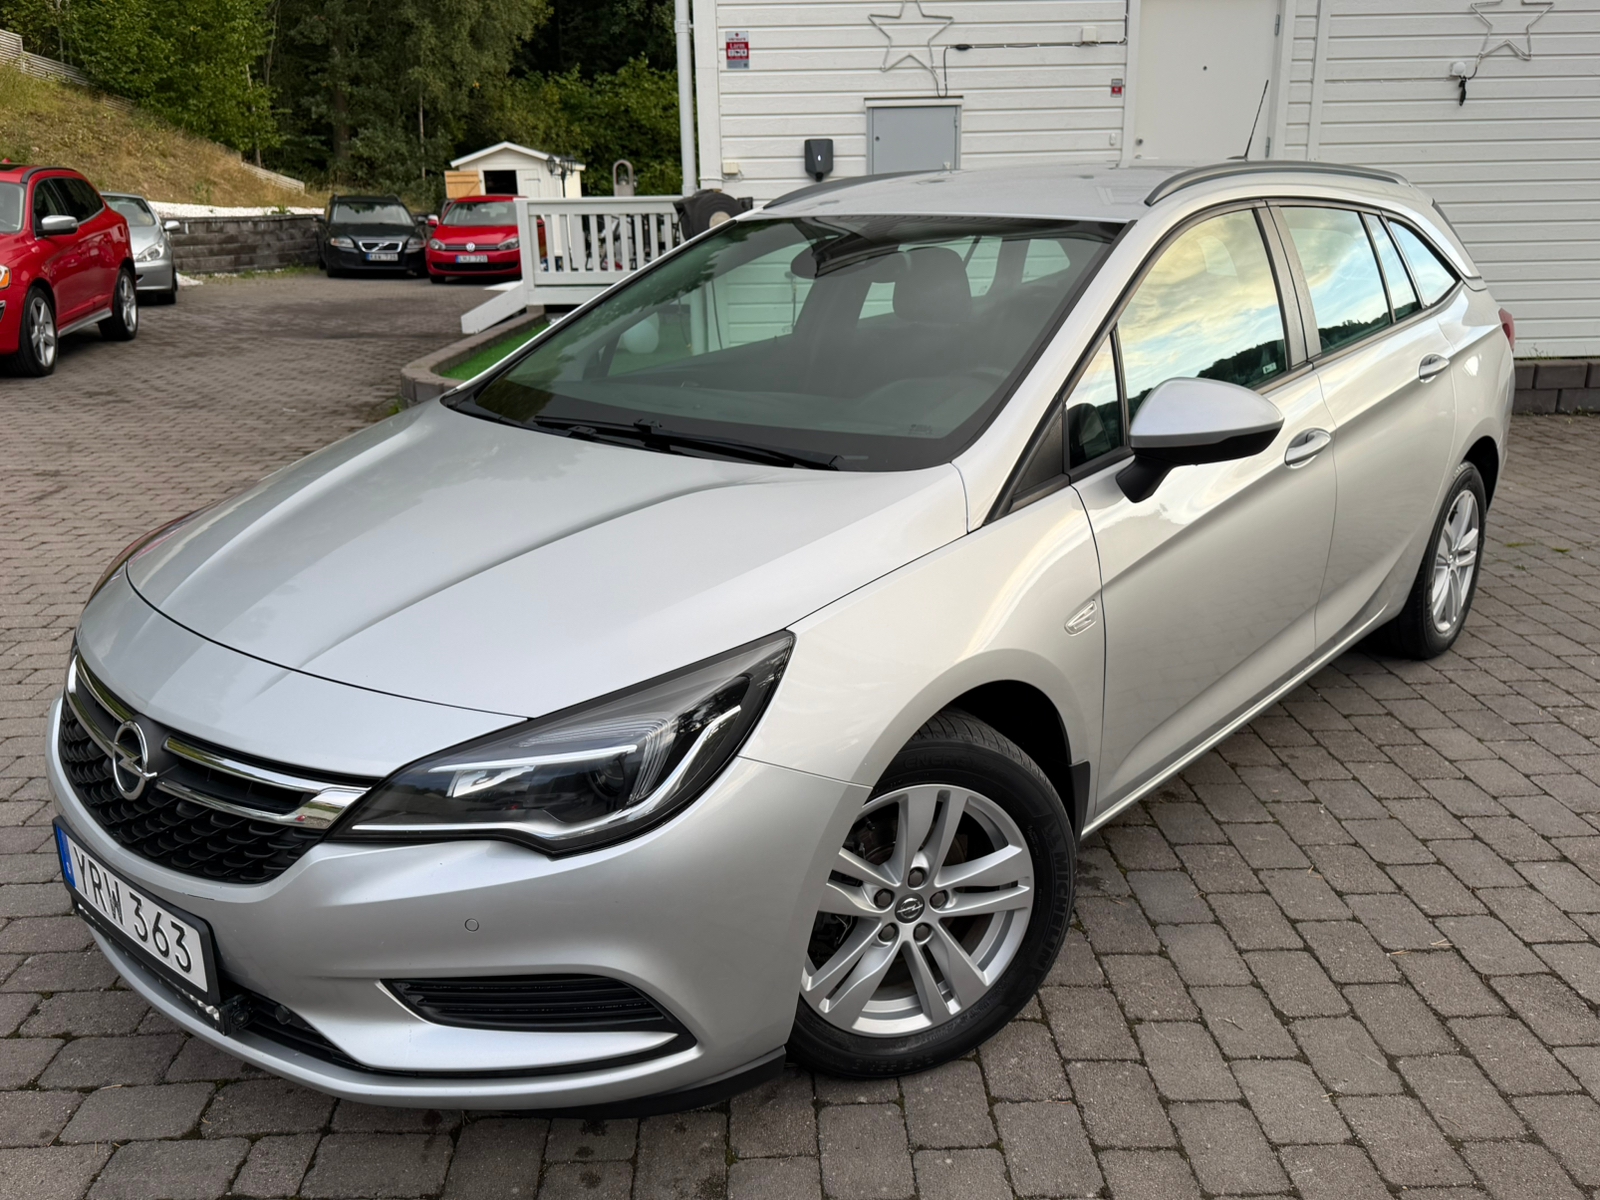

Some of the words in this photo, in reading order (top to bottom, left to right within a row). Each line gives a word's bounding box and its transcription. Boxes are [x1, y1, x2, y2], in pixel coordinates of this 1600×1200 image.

[73, 846, 124, 926] YRW
[129, 891, 192, 973] 363
[1037, 851, 1069, 971] MICHELIN
